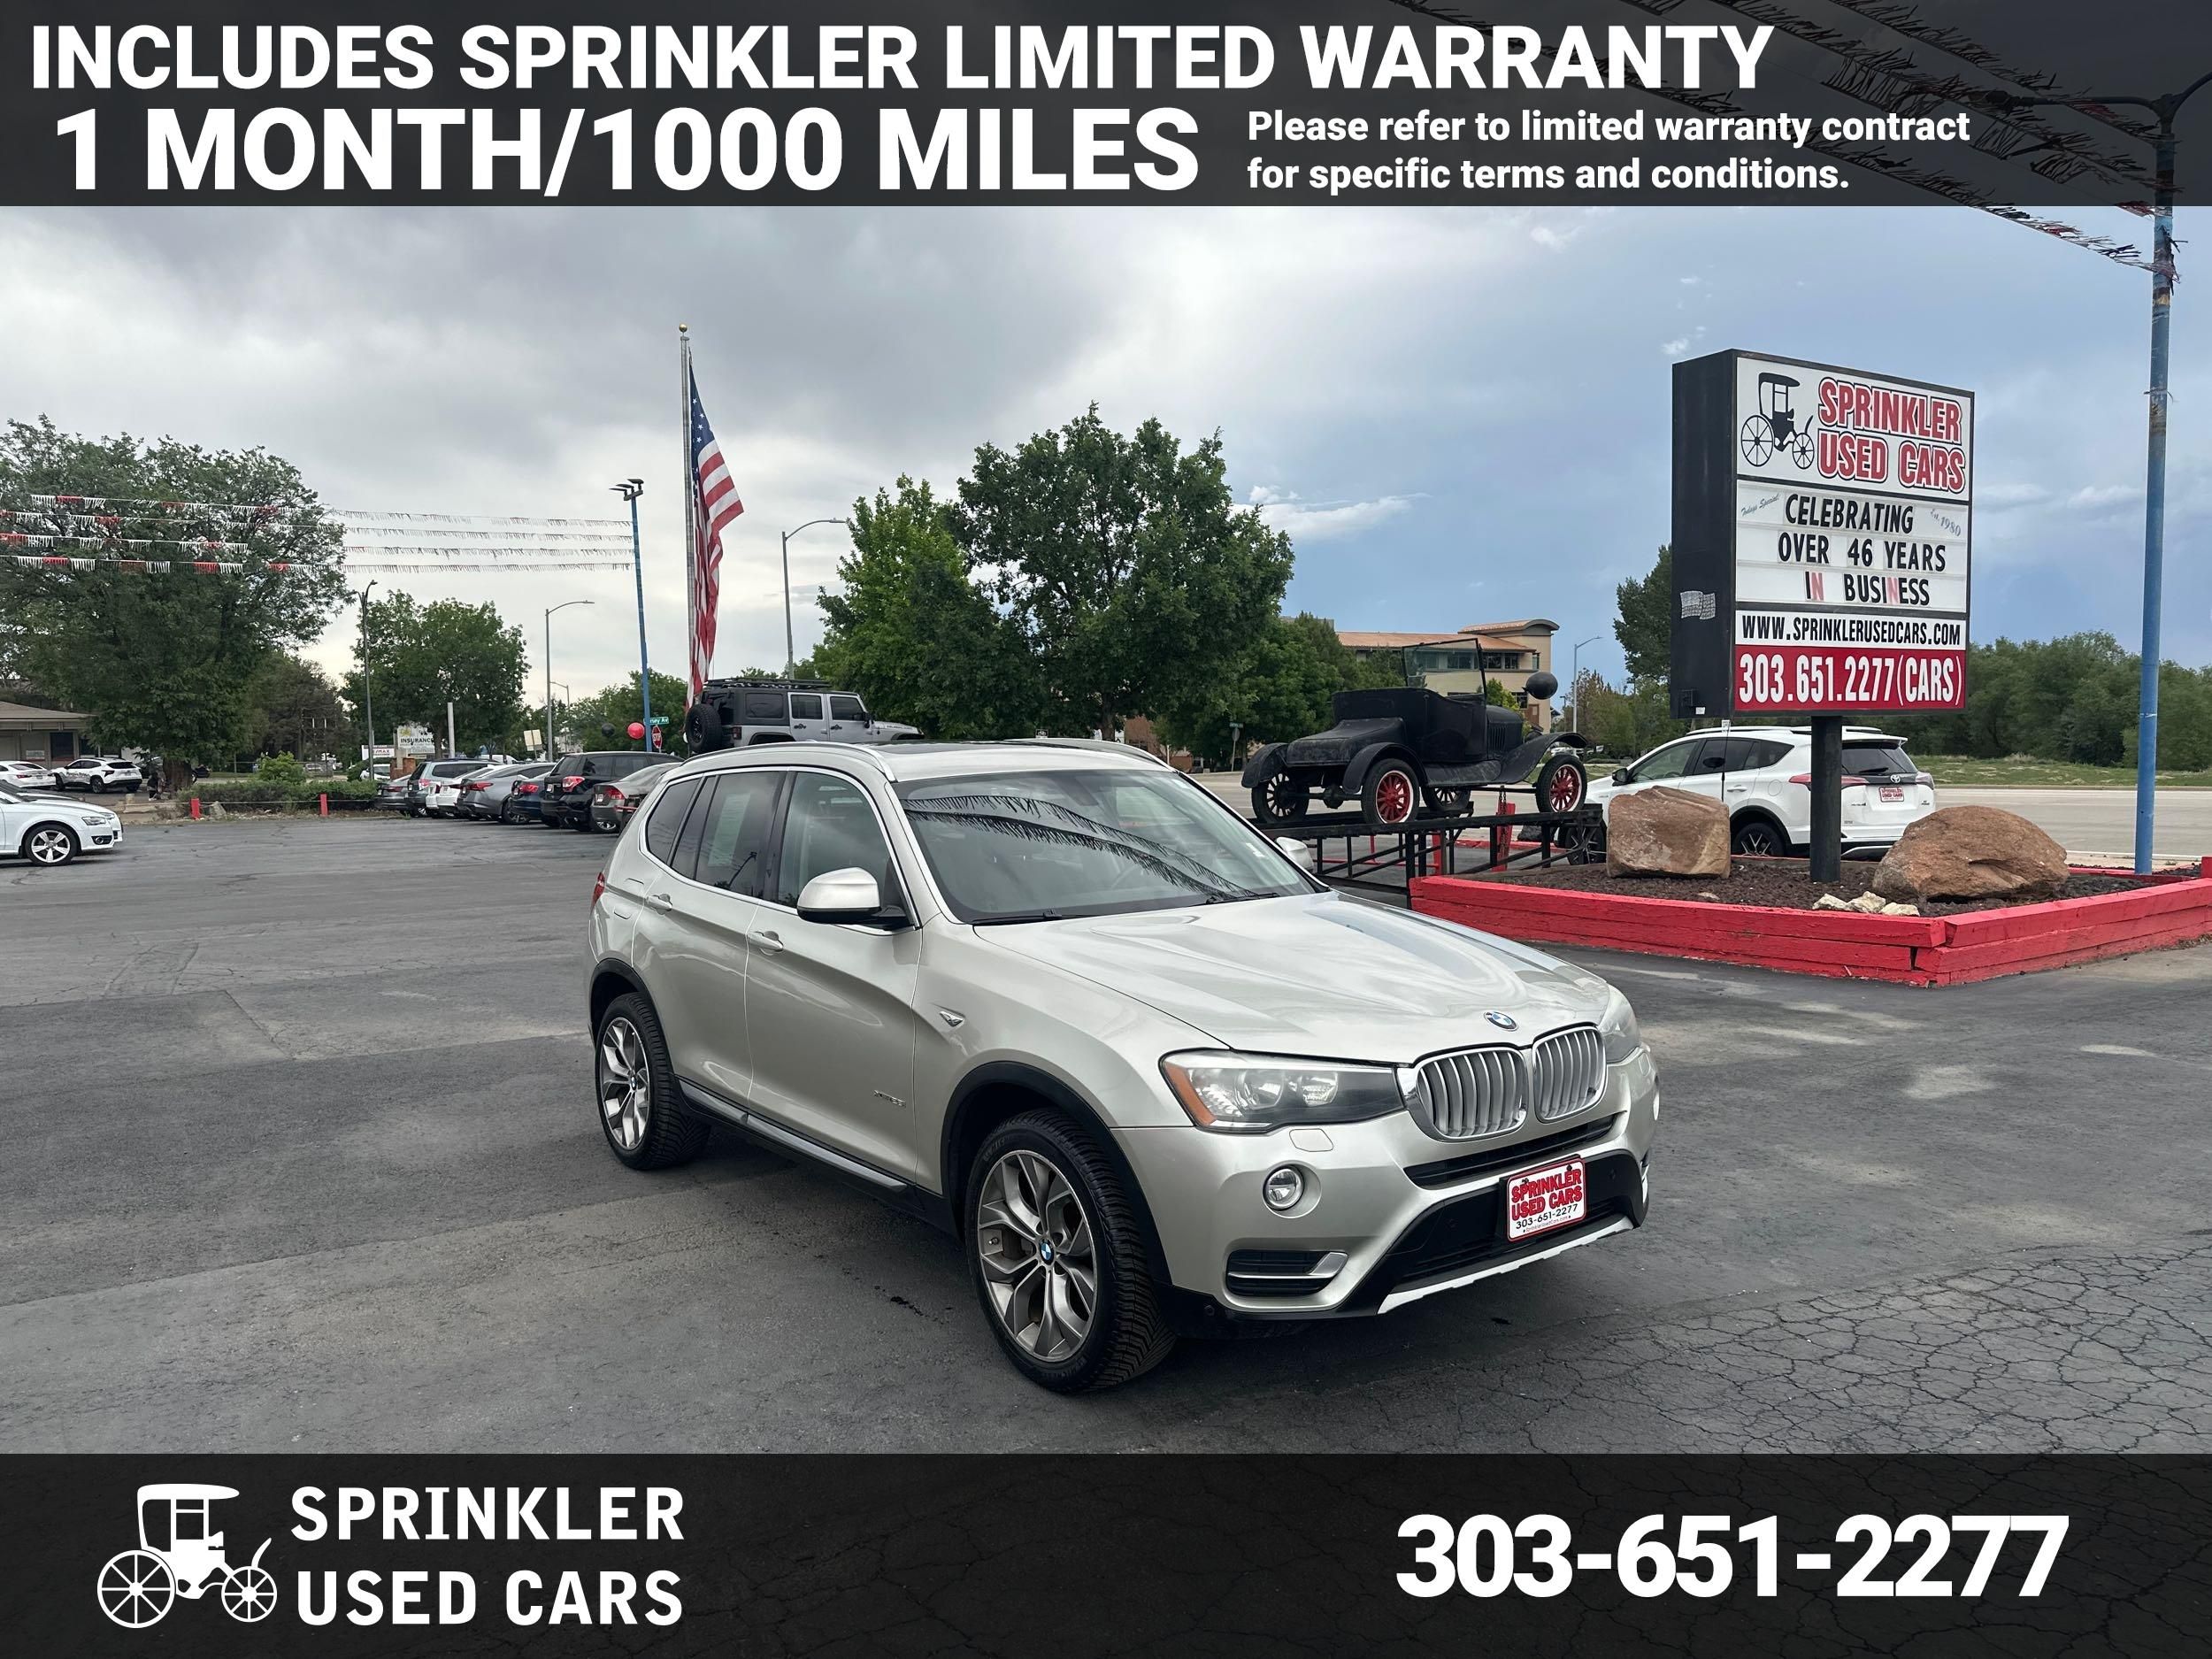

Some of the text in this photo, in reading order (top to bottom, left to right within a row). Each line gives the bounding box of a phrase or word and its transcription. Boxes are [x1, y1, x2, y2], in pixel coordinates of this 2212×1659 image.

[1818, 377, 1962, 446] SPRINKLER
[1817, 428, 1965, 493] USED CARS
[1786, 493, 1914, 534] CELEBRATING
[1939, 516, 1962, 537] 1980
[1778, 532, 1946, 572] OVER 46 YEARS
[1805, 571, 1930, 606] IN BUSINESS
[1741, 614, 1961, 646] WWW.SPRINKLERUSEDCARS.COM
[1511, 1169, 1582, 1203] SPRINKLER
[1511, 1186, 1583, 1221] USED CARS
[1516, 1203, 1578, 1229] 303-651-2277
